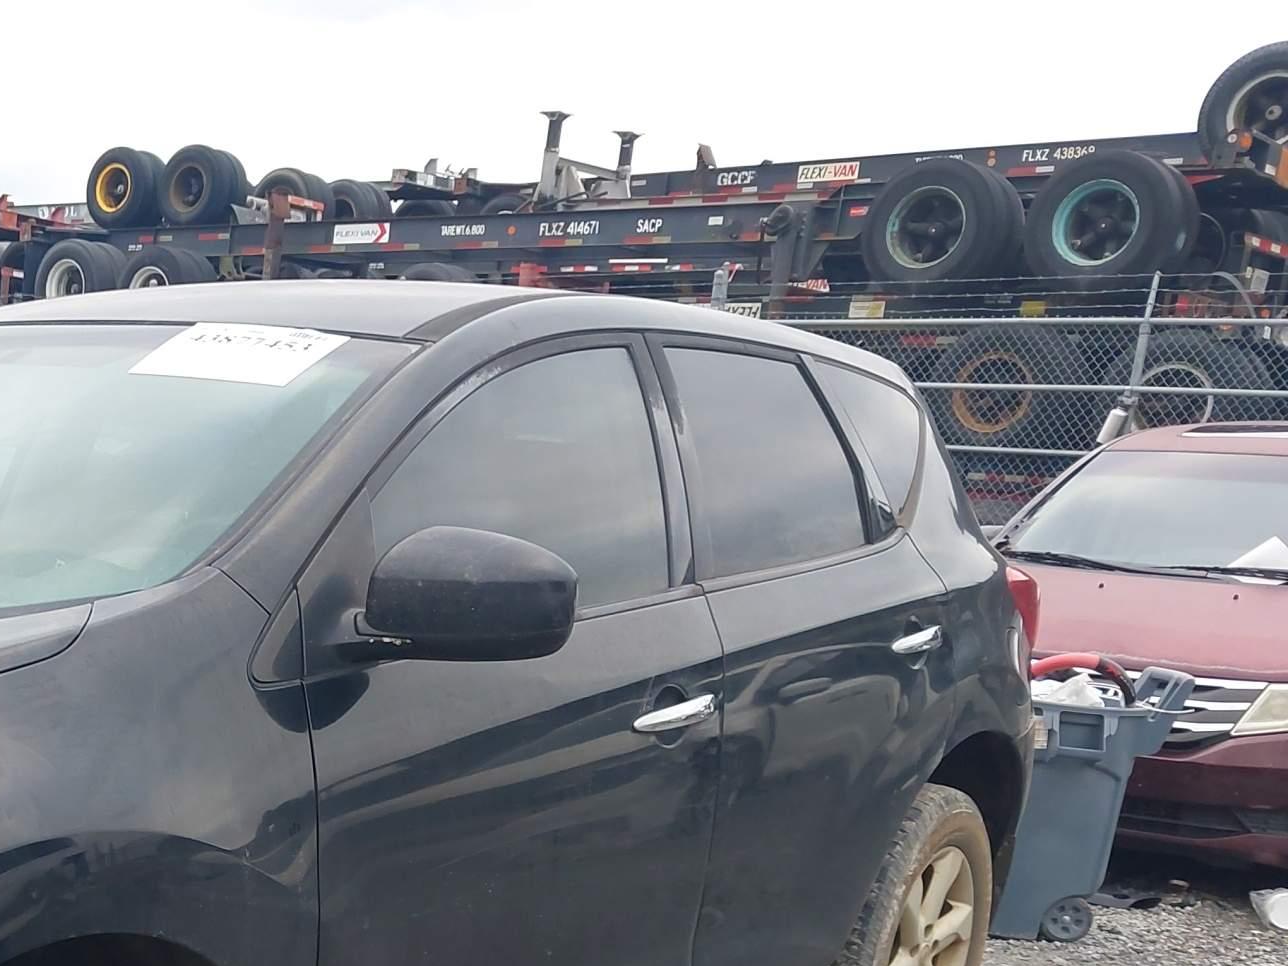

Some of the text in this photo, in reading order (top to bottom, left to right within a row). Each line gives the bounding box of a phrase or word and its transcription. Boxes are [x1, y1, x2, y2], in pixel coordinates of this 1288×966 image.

[1022, 149, 1049, 162] FLXZ
[799, 164, 858, 181] FLEXI-VAN
[539, 220, 599, 236] FLXZ 414671
[636, 218, 663, 233] SACP
